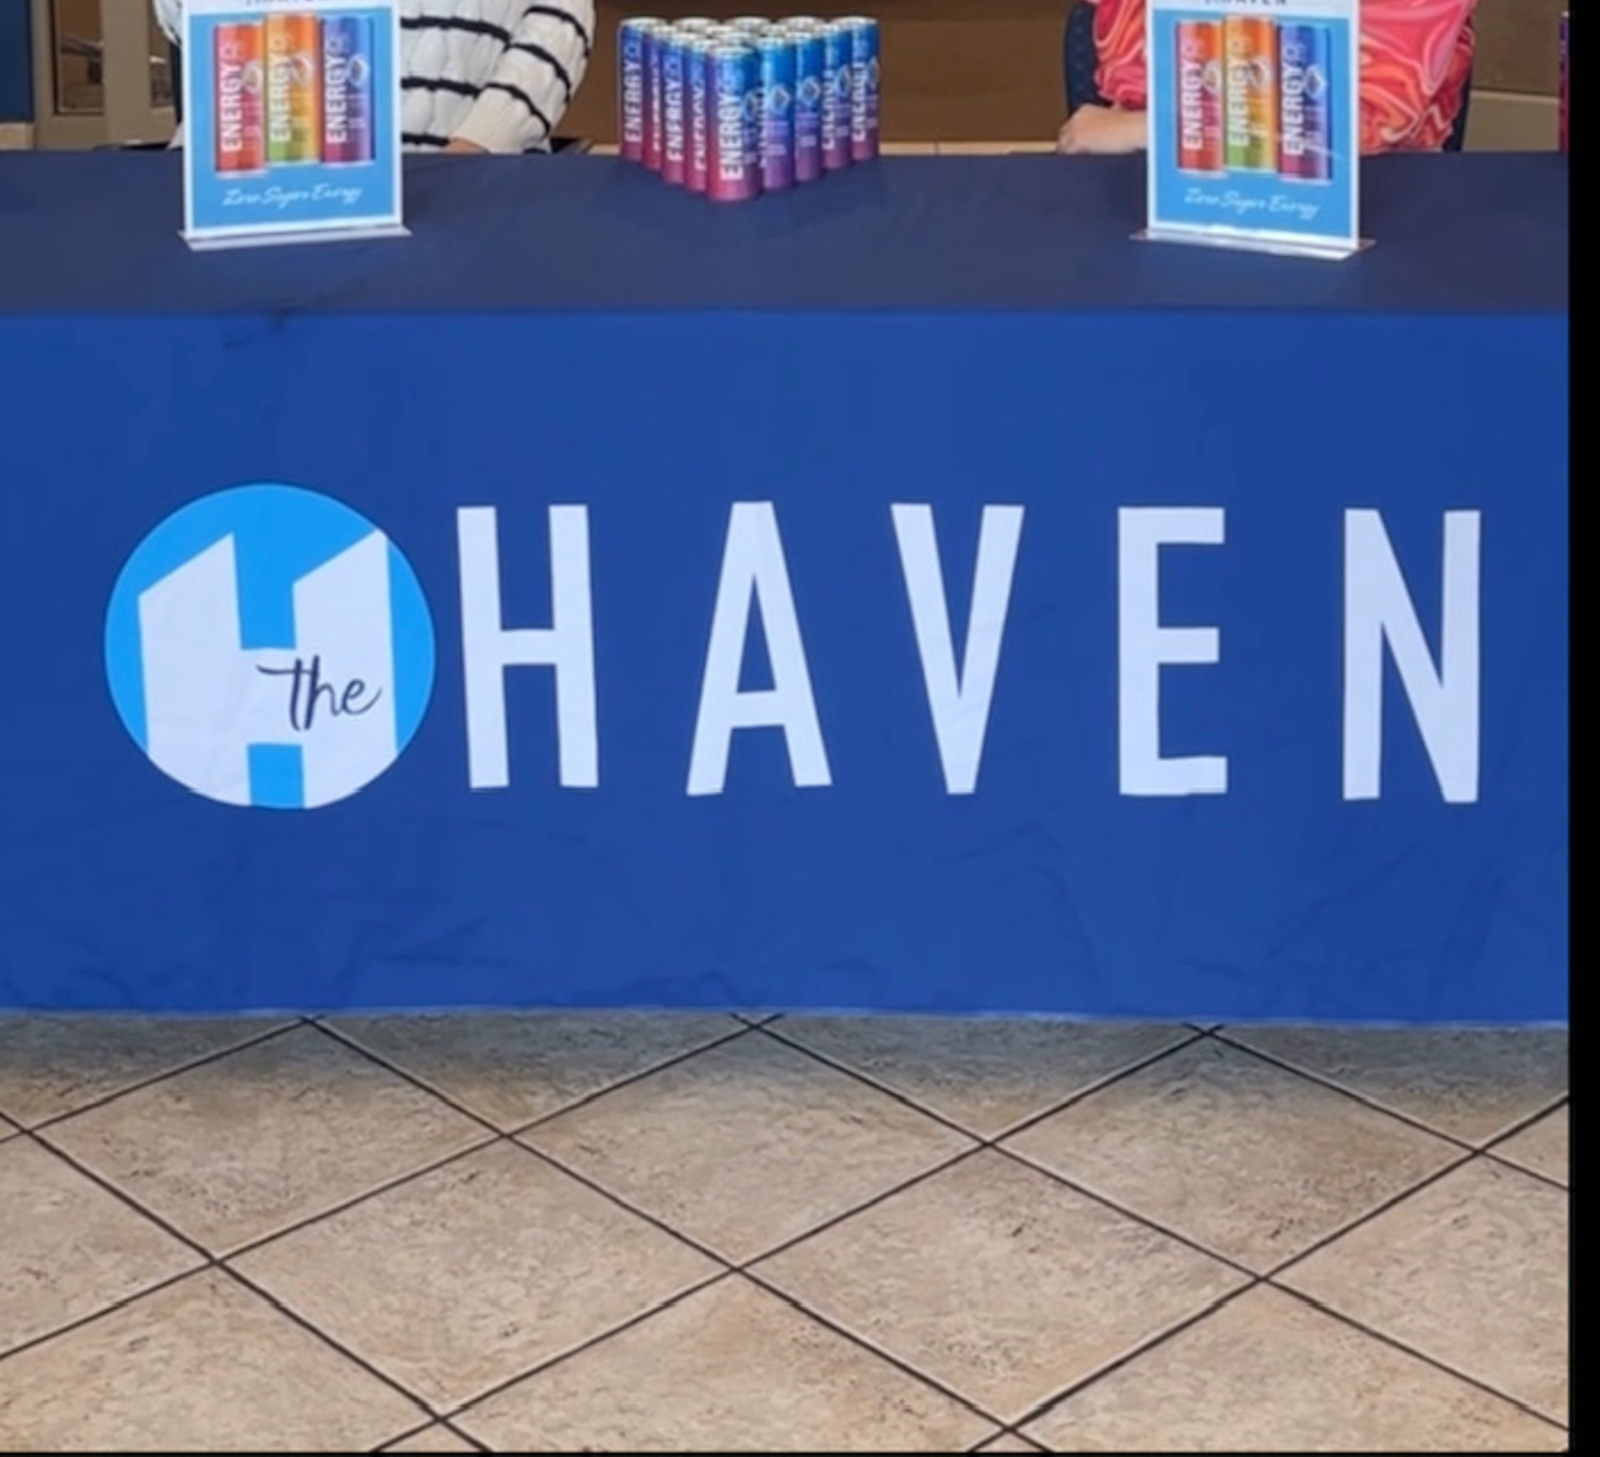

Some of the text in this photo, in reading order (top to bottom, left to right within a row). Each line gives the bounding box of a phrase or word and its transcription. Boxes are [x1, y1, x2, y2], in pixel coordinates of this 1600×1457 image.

[218, 62, 243, 154] ENERGY
[269, 53, 292, 143] ENERGY
[325, 55, 347, 145] ENERGY
[718, 92, 744, 181] ENERGY
[1181, 59, 1204, 151] ENERGY
[1226, 54, 1250, 148] ENERGY
[1281, 62, 1304, 156] ENERGY
[260, 185, 310, 210] Sugar
[311, 182, 365, 205] Energy
[1220, 190, 1266, 215] Sugar
[1267, 195, 1322, 221] Energy
[256, 501, 1481, 804] the HAVEN
